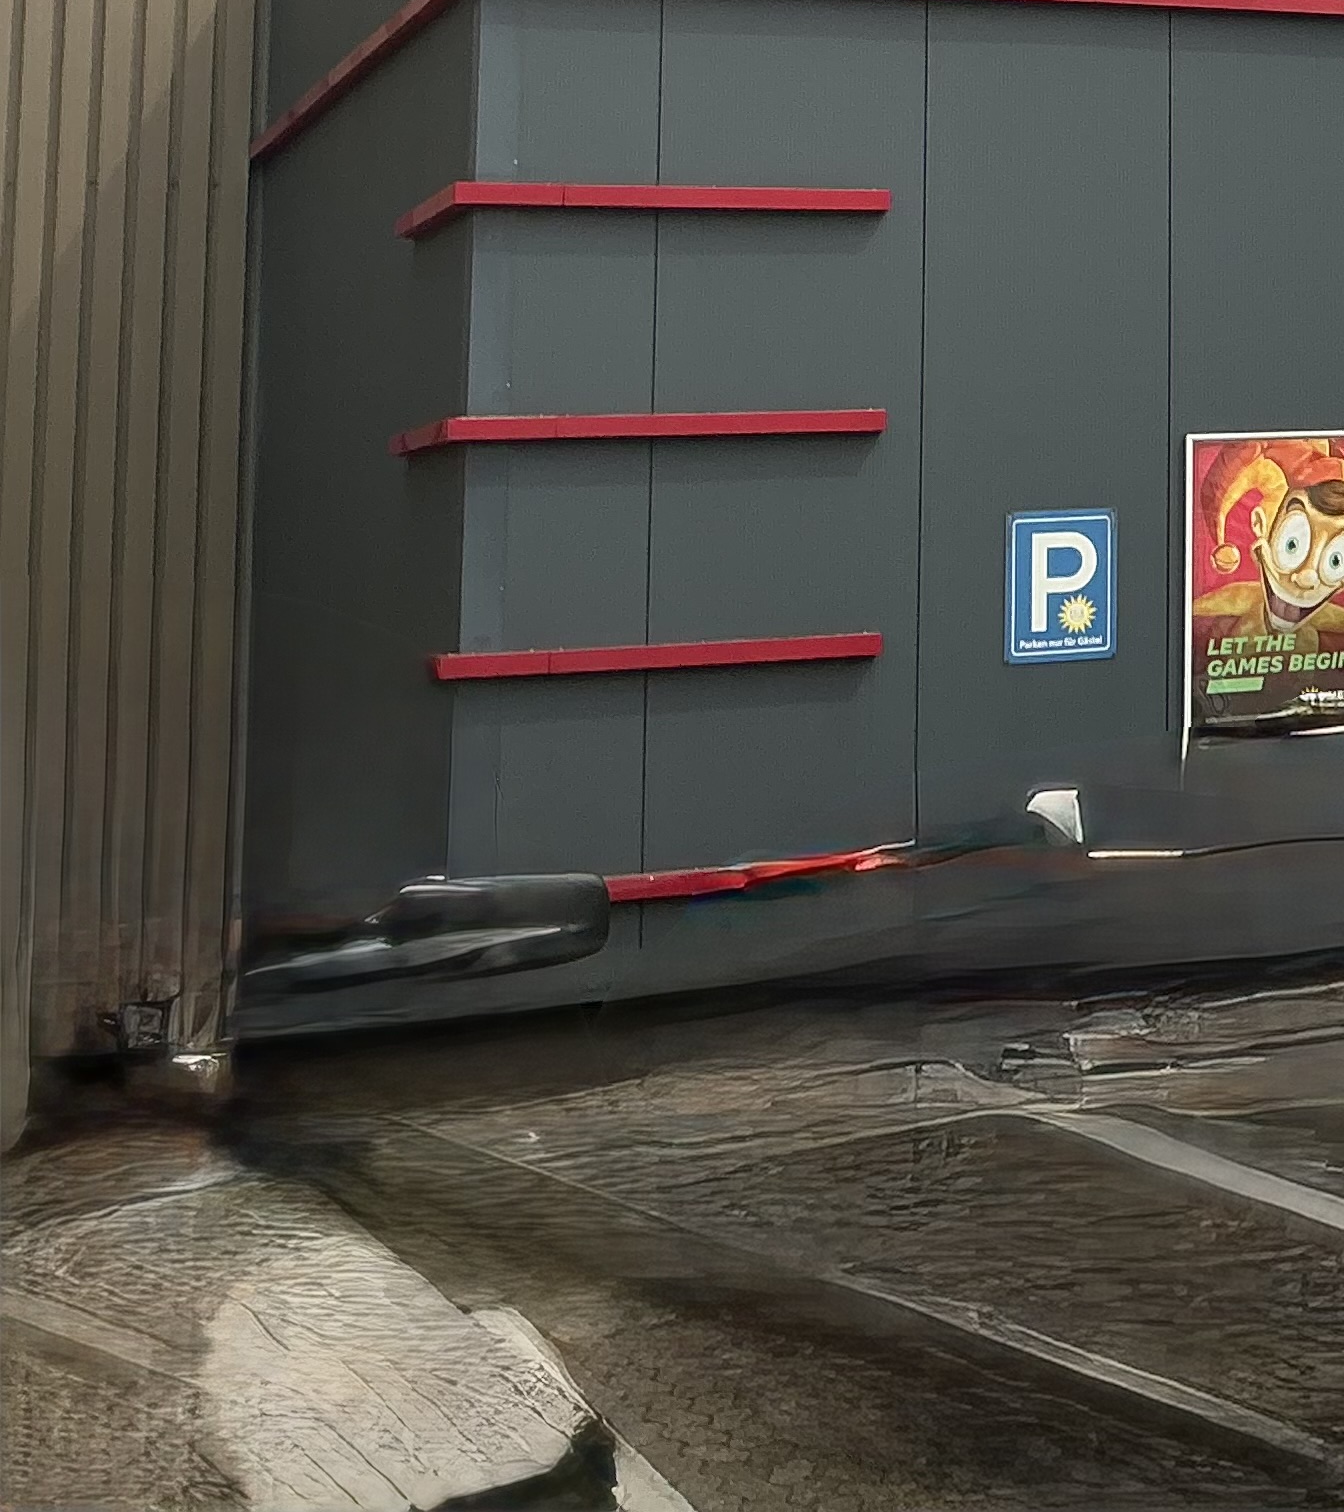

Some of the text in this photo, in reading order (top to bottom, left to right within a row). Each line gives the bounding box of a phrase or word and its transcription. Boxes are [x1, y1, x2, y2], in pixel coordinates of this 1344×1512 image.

[1031, 532, 1098, 633] P
[1207, 633, 1296, 656] LET THE
[1207, 655, 1284, 677] GAMES
